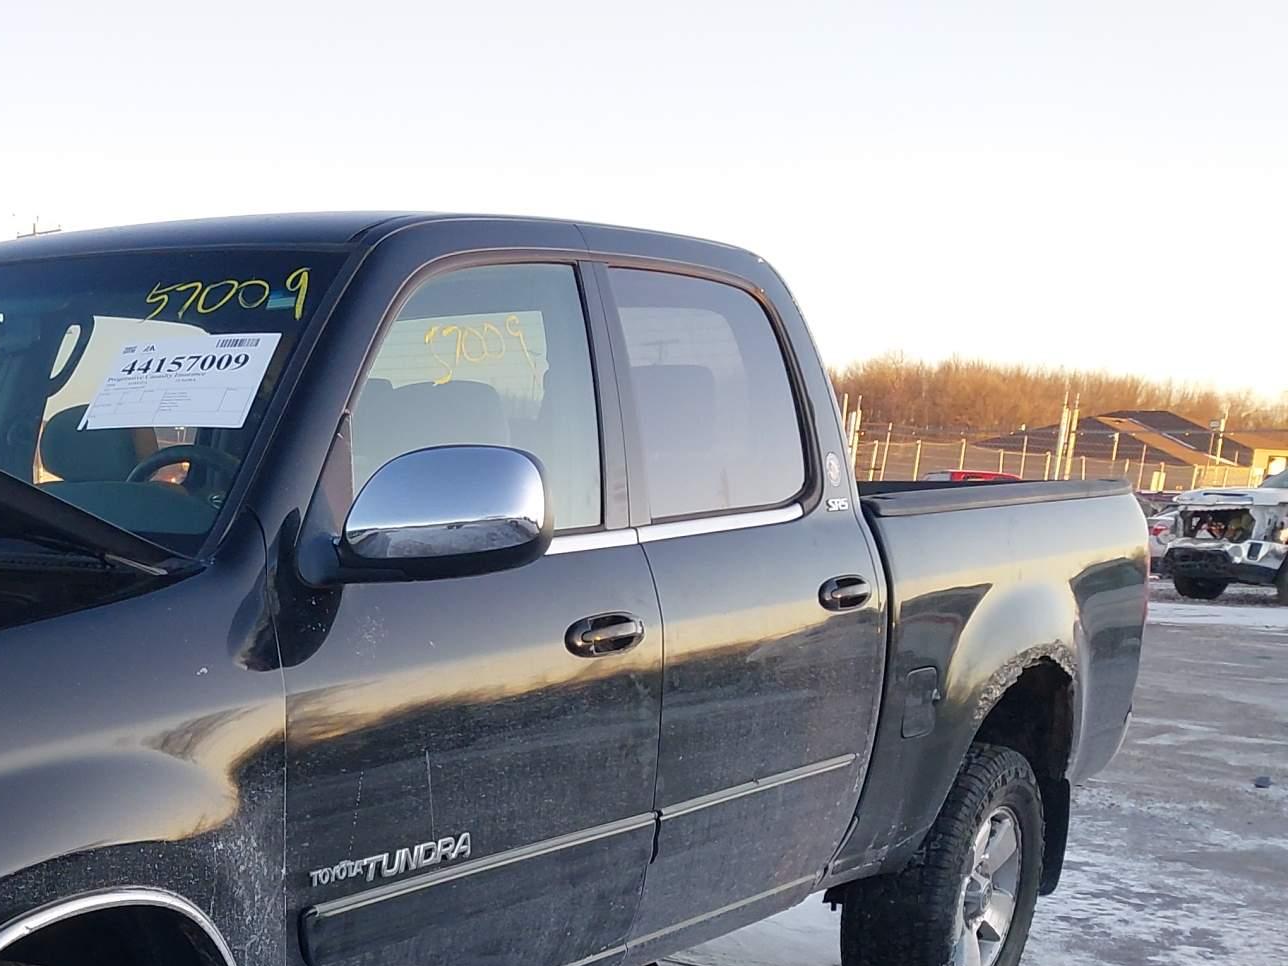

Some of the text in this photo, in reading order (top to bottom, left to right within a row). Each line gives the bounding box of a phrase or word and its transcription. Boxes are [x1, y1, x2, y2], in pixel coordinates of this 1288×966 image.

[120, 353, 250, 376] 44157009
[310, 832, 472, 887] TOYOTA TUNDRA
